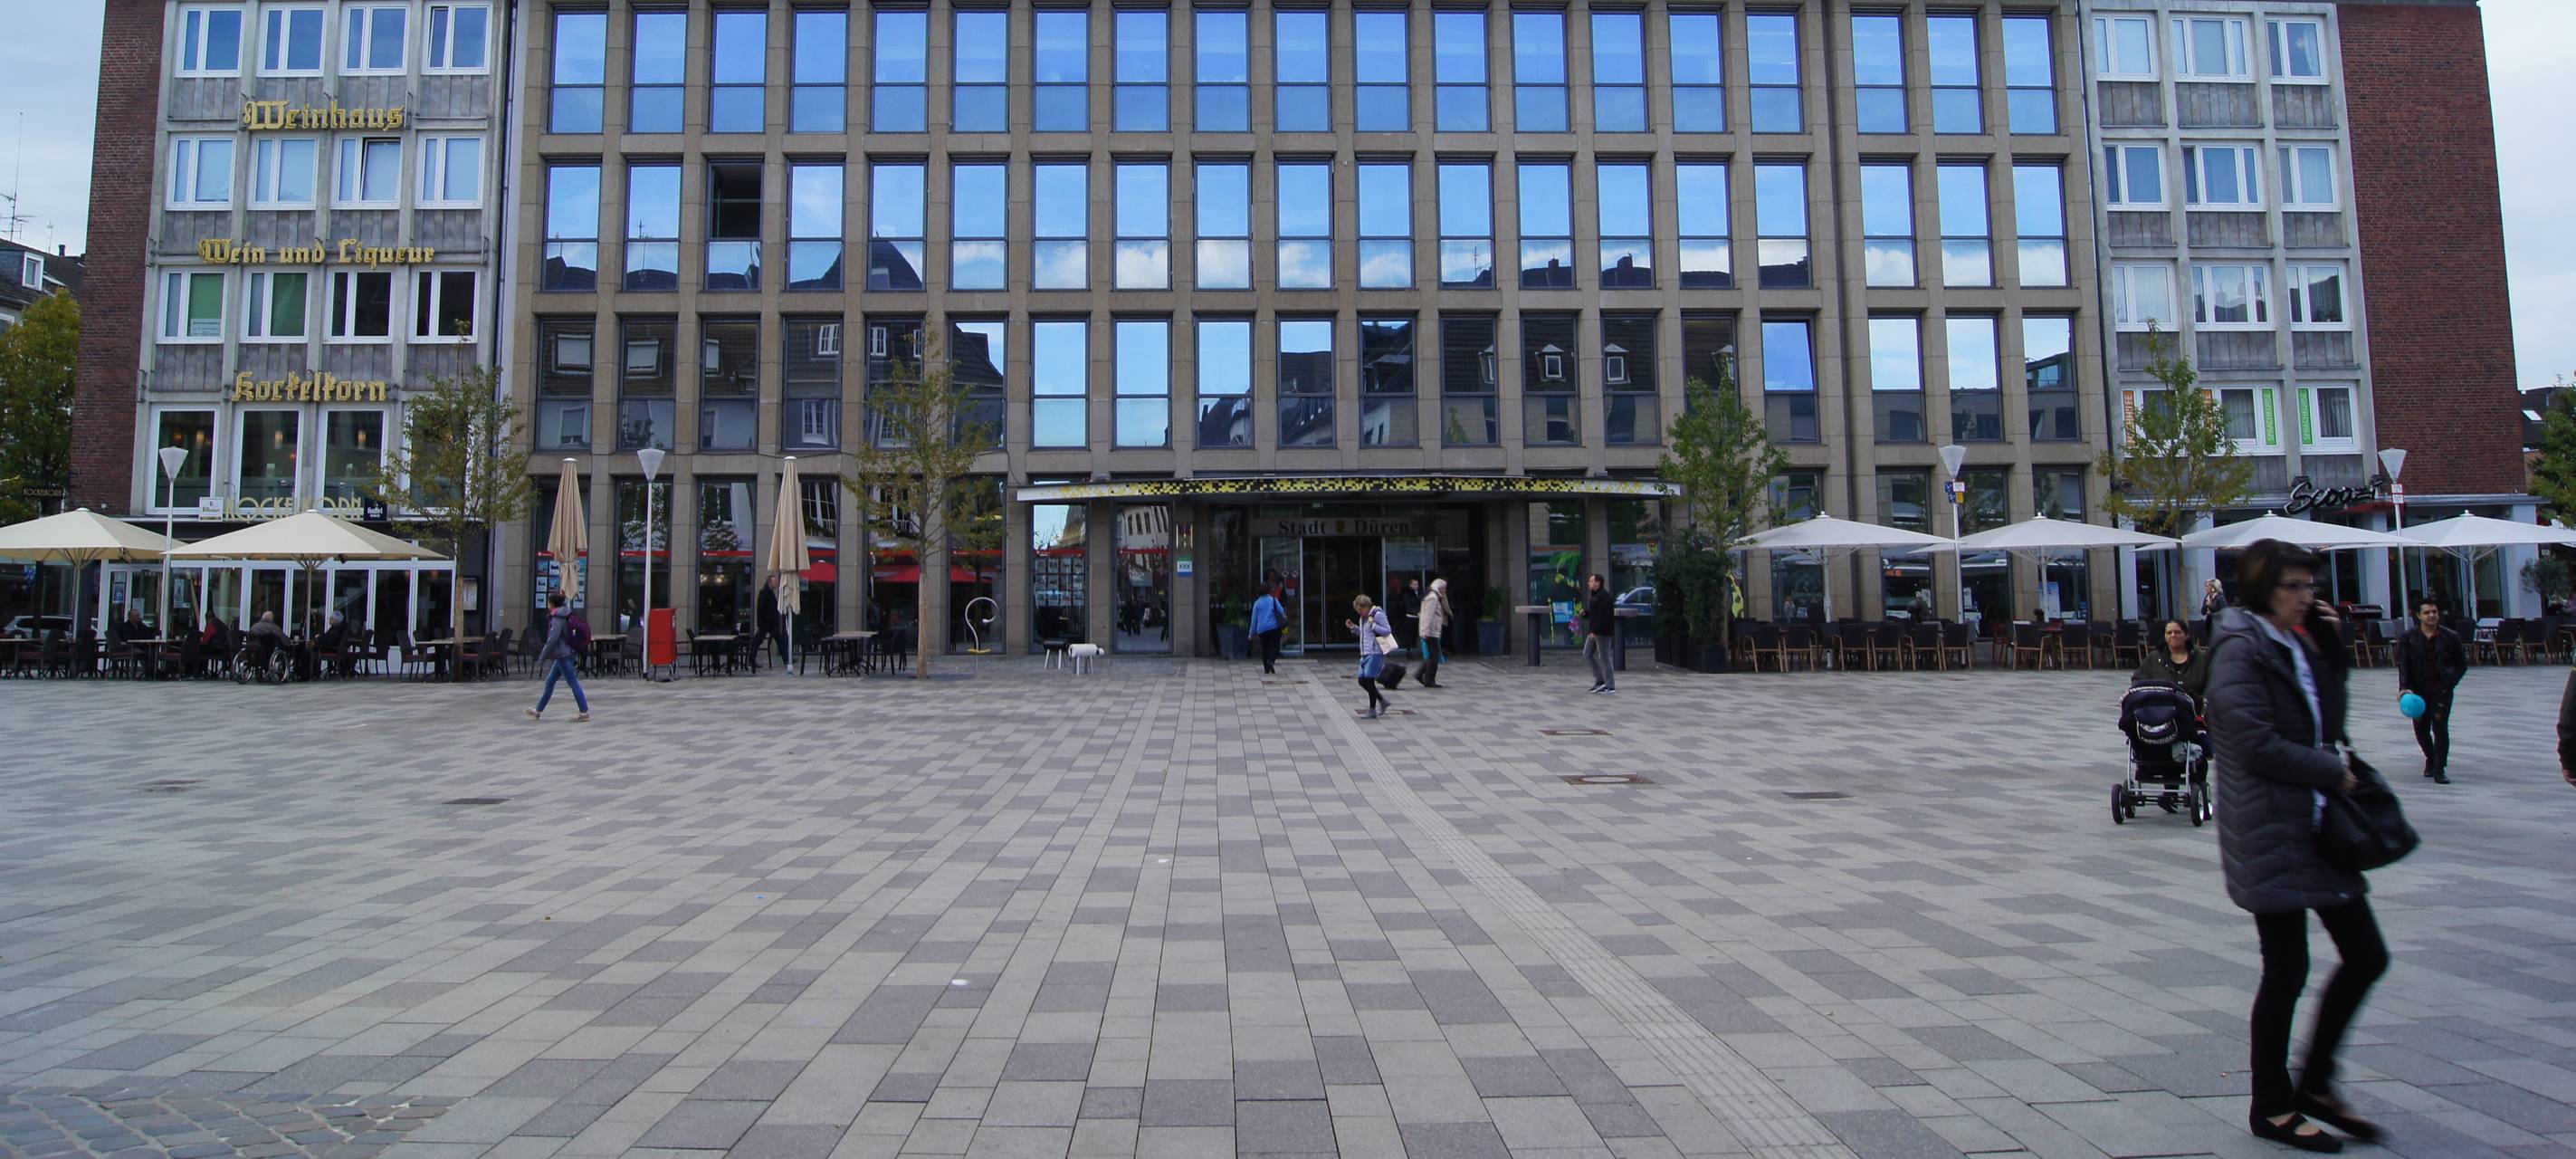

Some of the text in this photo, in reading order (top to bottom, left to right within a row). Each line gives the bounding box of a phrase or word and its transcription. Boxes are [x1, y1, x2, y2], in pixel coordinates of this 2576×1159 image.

[244, 101, 405, 131] Weinhaus
[198, 238, 435, 270] Wein und Liqueur
[232, 371, 387, 401] Kockelkorn
[1278, 519, 1410, 535] Stadt Düren
